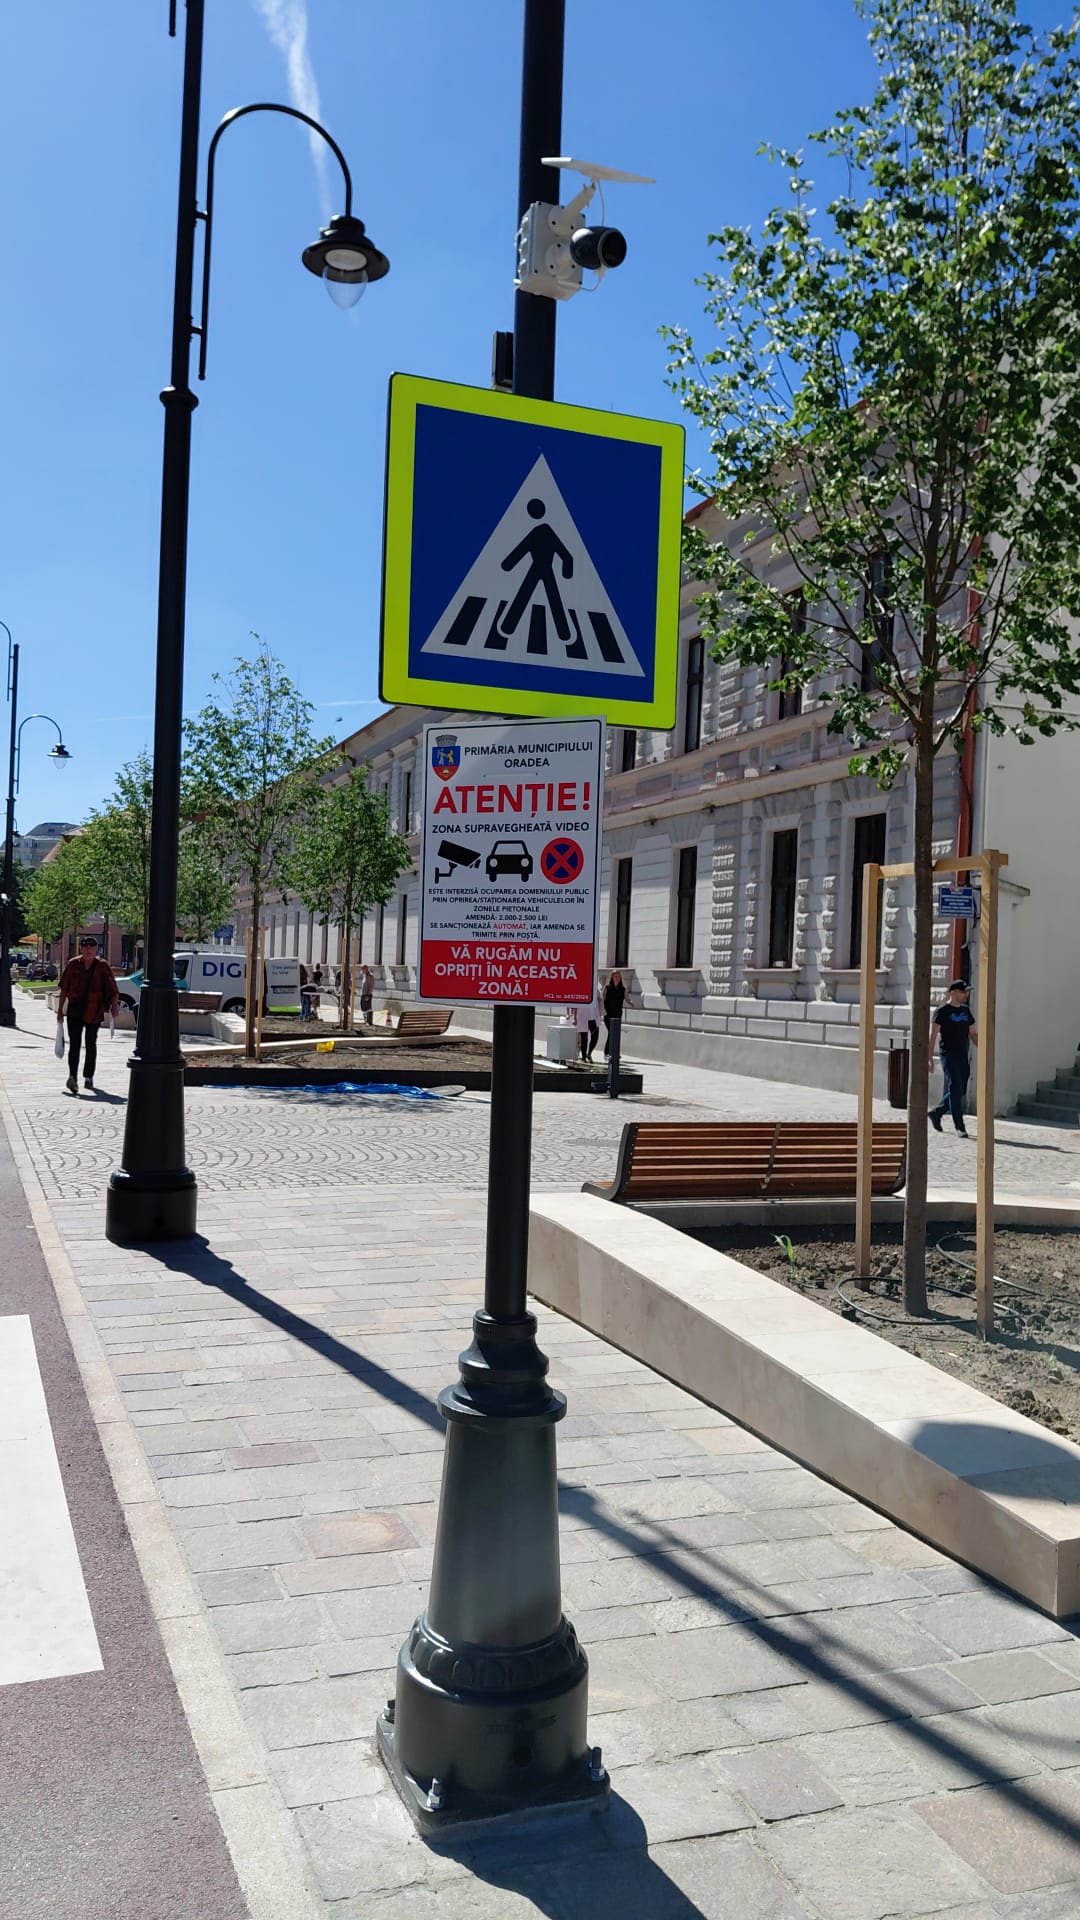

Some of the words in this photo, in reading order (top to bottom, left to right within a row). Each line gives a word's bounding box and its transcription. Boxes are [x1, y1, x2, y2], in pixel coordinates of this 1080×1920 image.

[464, 744, 515, 756] PRIMĂRIA
[518, 741, 593, 753] MUNICIPIULUI
[504, 757, 550, 769] ORADEA
[433, 781, 591, 818] ATENȚIE!
[432, 824, 462, 834] ZONA
[464, 821, 552, 833] SUPRAVEGHEATĂ
[555, 821, 590, 832] VIDEO
[445, 887, 479, 895] INTERZISĂ
[449, 896, 526, 905] OPRIREA/STAȚIONAREA
[576, 896, 585, 904] ÎN
[465, 913, 498, 921] AMENDĂ:
[439, 921, 492, 931] SANCȚIONEAZĂ
[450, 943, 471, 960] VĂ
[475, 944, 533, 961] RUGĂM
[537, 947, 561, 962] NU
[434, 962, 482, 981] OPRIȚI
[486, 961, 503, 978] ÎN
[506, 963, 578, 980] ACEASTĂ
[478, 979, 529, 996] ZONĂ!
